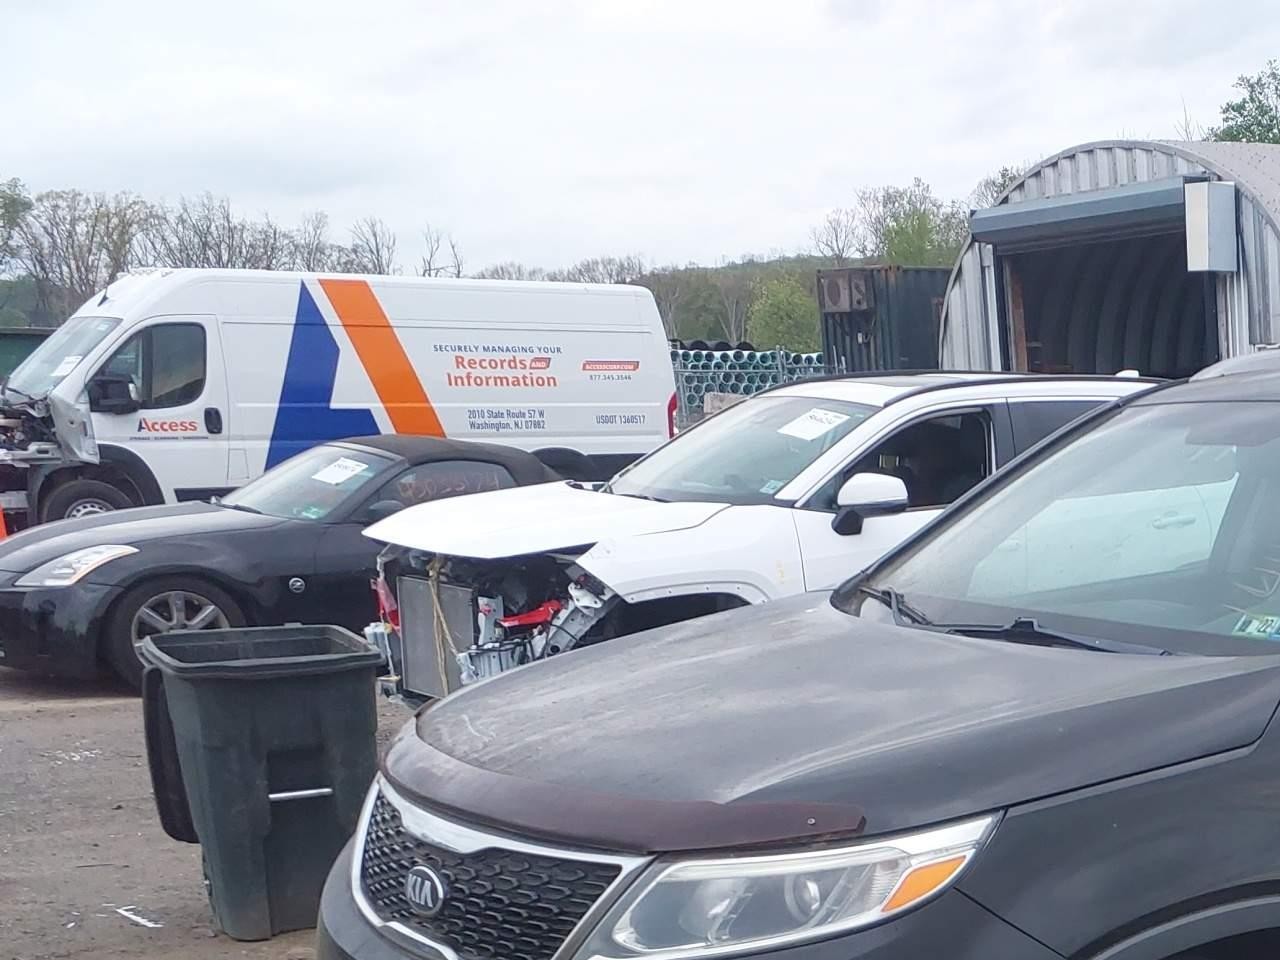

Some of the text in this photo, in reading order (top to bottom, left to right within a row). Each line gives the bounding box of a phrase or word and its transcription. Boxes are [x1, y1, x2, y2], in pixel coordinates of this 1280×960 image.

[433, 344, 562, 354] SECURELY MANAGING YOUR
[454, 355, 527, 370] Records
[446, 372, 557, 387] Information
[467, 409, 545, 419] 2010 State Route 57 W
[596, 415, 645, 424] USDOT 1360517
[138, 417, 197, 432] Access
[469, 420, 545, 431] Washington, NJ 07882
